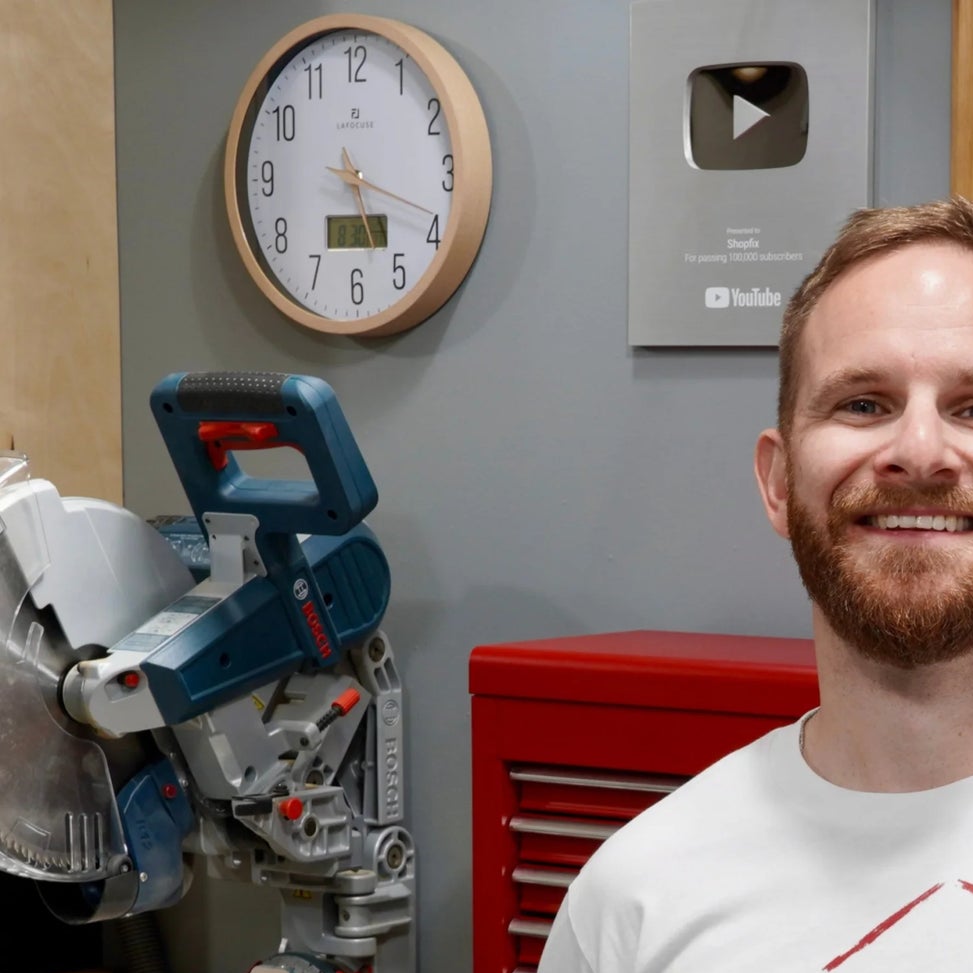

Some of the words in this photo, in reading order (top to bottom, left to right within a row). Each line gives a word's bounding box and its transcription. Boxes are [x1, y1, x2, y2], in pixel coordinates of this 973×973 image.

[304, 63, 323, 100] 11
[344, 45, 367, 83] 12
[395, 58, 404, 96] 1
[272, 104, 296, 142] 10
[427, 98, 441, 136] 2
[261, 160, 275, 197] 9
[442, 154, 455, 192] 3
[275, 217, 288, 254] 8
[426, 214, 441, 251] 4
[727, 237, 760, 251] Shopfix
[308, 255, 321, 290] 7
[392, 253, 406, 290] 5
[684, 253, 697, 262] For
[698, 253, 728, 264] passing
[729, 252, 759, 263] 100,000
[760, 252, 803, 262] subscribers
[350, 268, 364, 305] 6
[731, 287, 781, 308] YouTube
[302, 600, 332, 660] BOSCH
[384, 737, 399, 819] BOSCH
